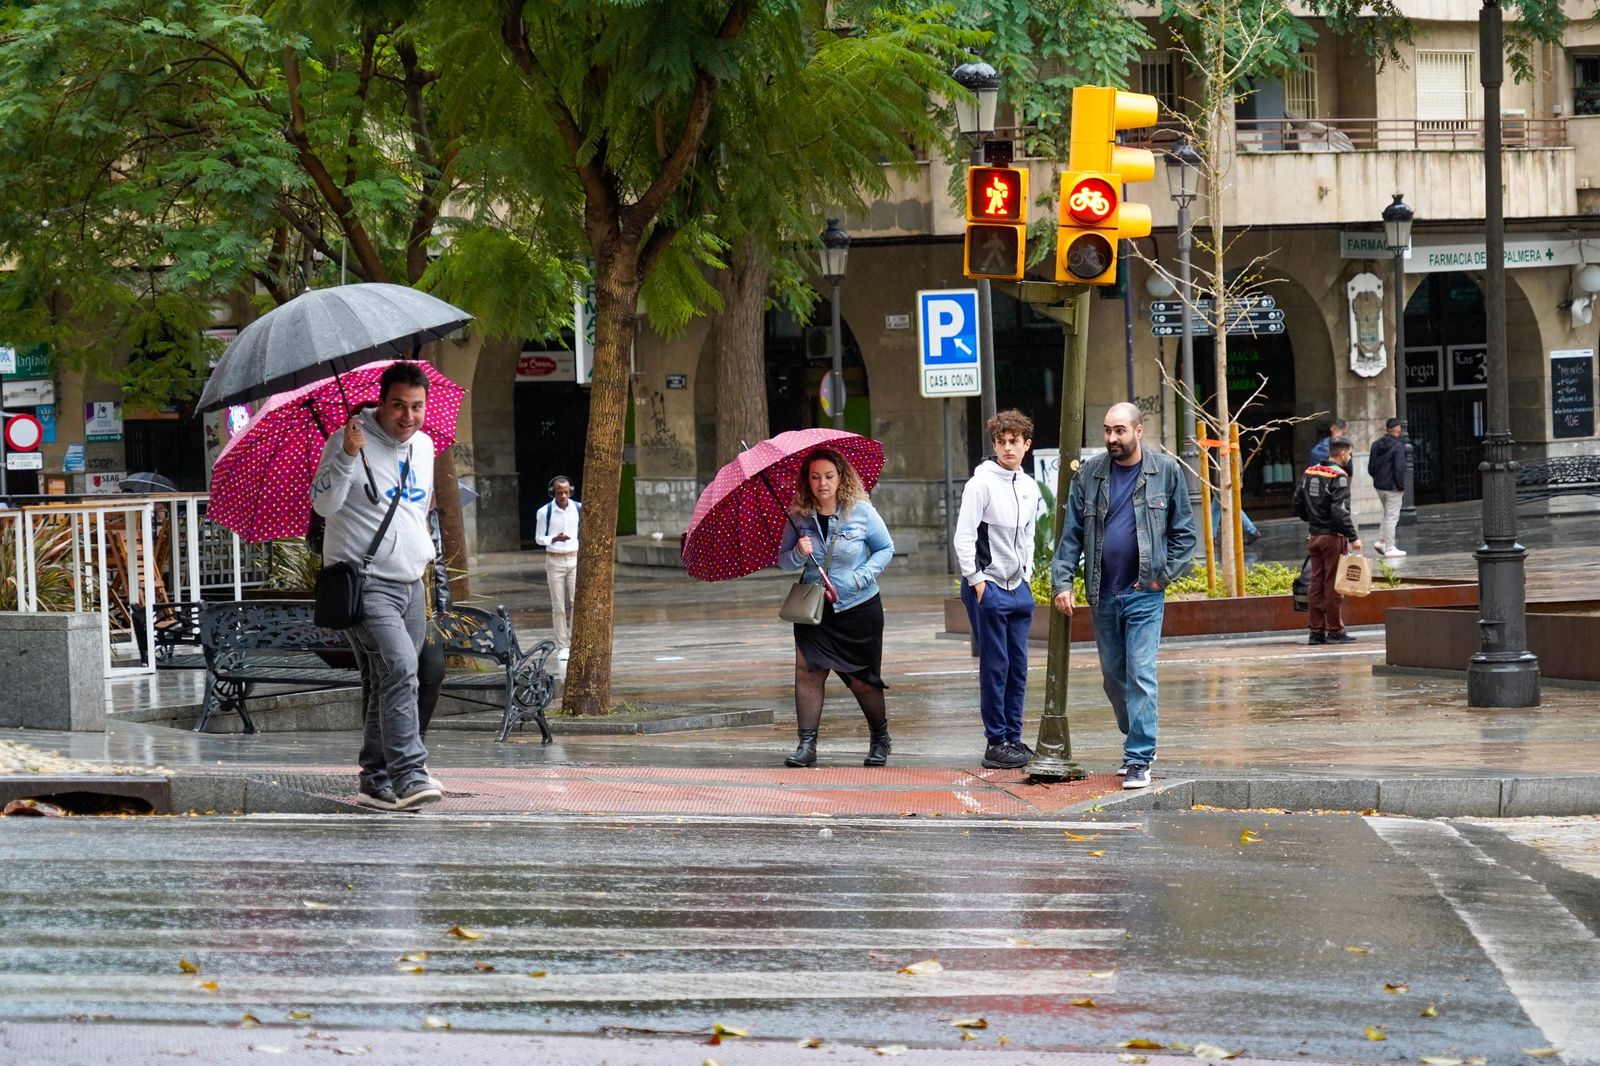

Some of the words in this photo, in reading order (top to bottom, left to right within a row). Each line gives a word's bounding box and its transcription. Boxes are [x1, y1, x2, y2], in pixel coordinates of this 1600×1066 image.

[1429, 253, 1472, 266] FARMACIA
[927, 299, 965, 357] P
[929, 376, 949, 388] CASA
[951, 374, 975, 387] COLON
[101, 474, 120, 482] SEAG
